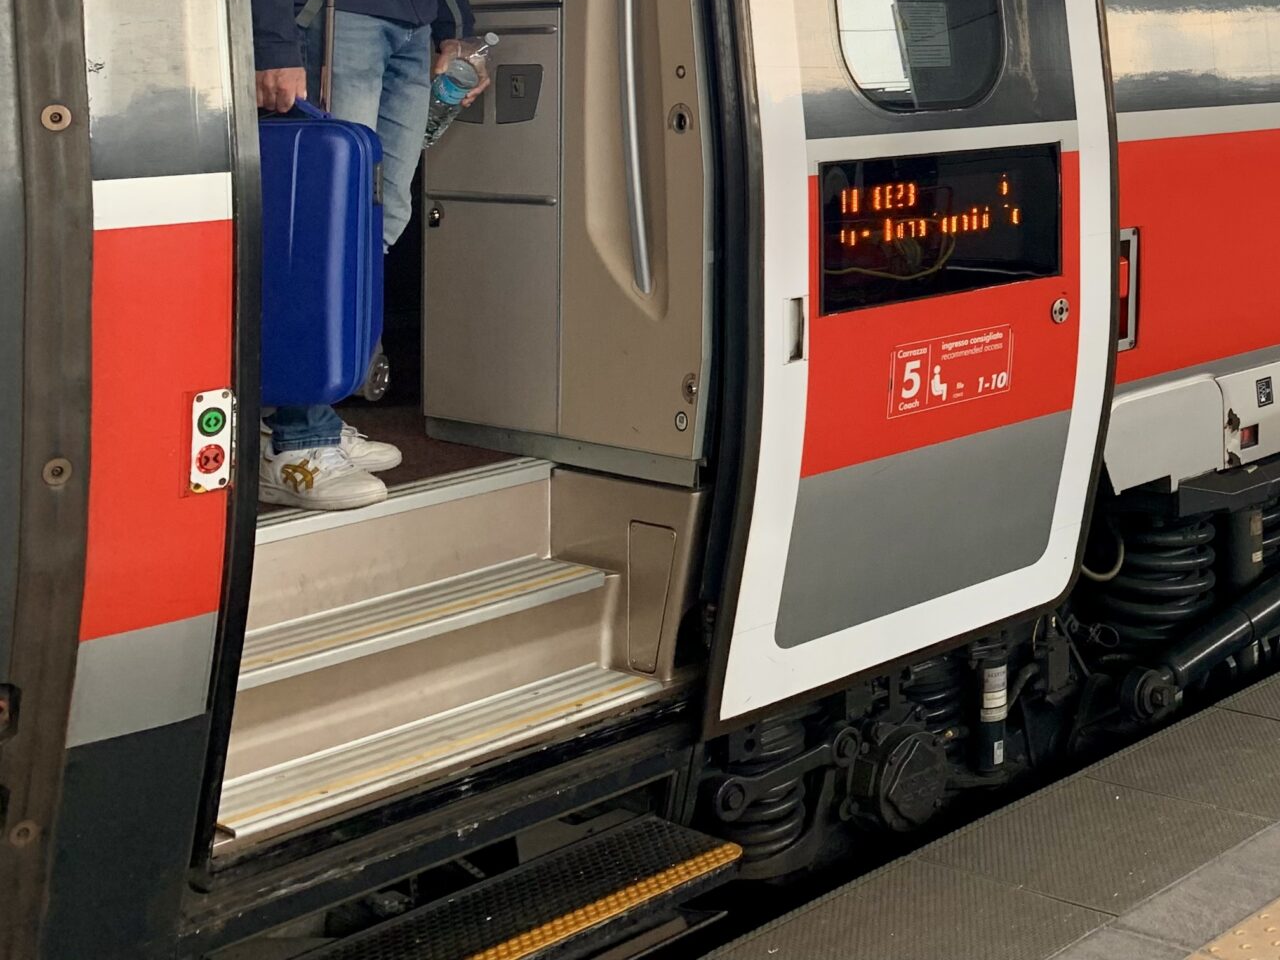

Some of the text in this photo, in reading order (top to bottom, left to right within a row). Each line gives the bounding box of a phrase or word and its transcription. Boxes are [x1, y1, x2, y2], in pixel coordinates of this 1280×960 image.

[941, 332, 1003, 350] ingresso consigliato
[941, 344, 983, 360] recommended
[901, 360, 921, 399] 5
[977, 371, 1008, 393] 1-10
[898, 399, 920, 411] Coach
